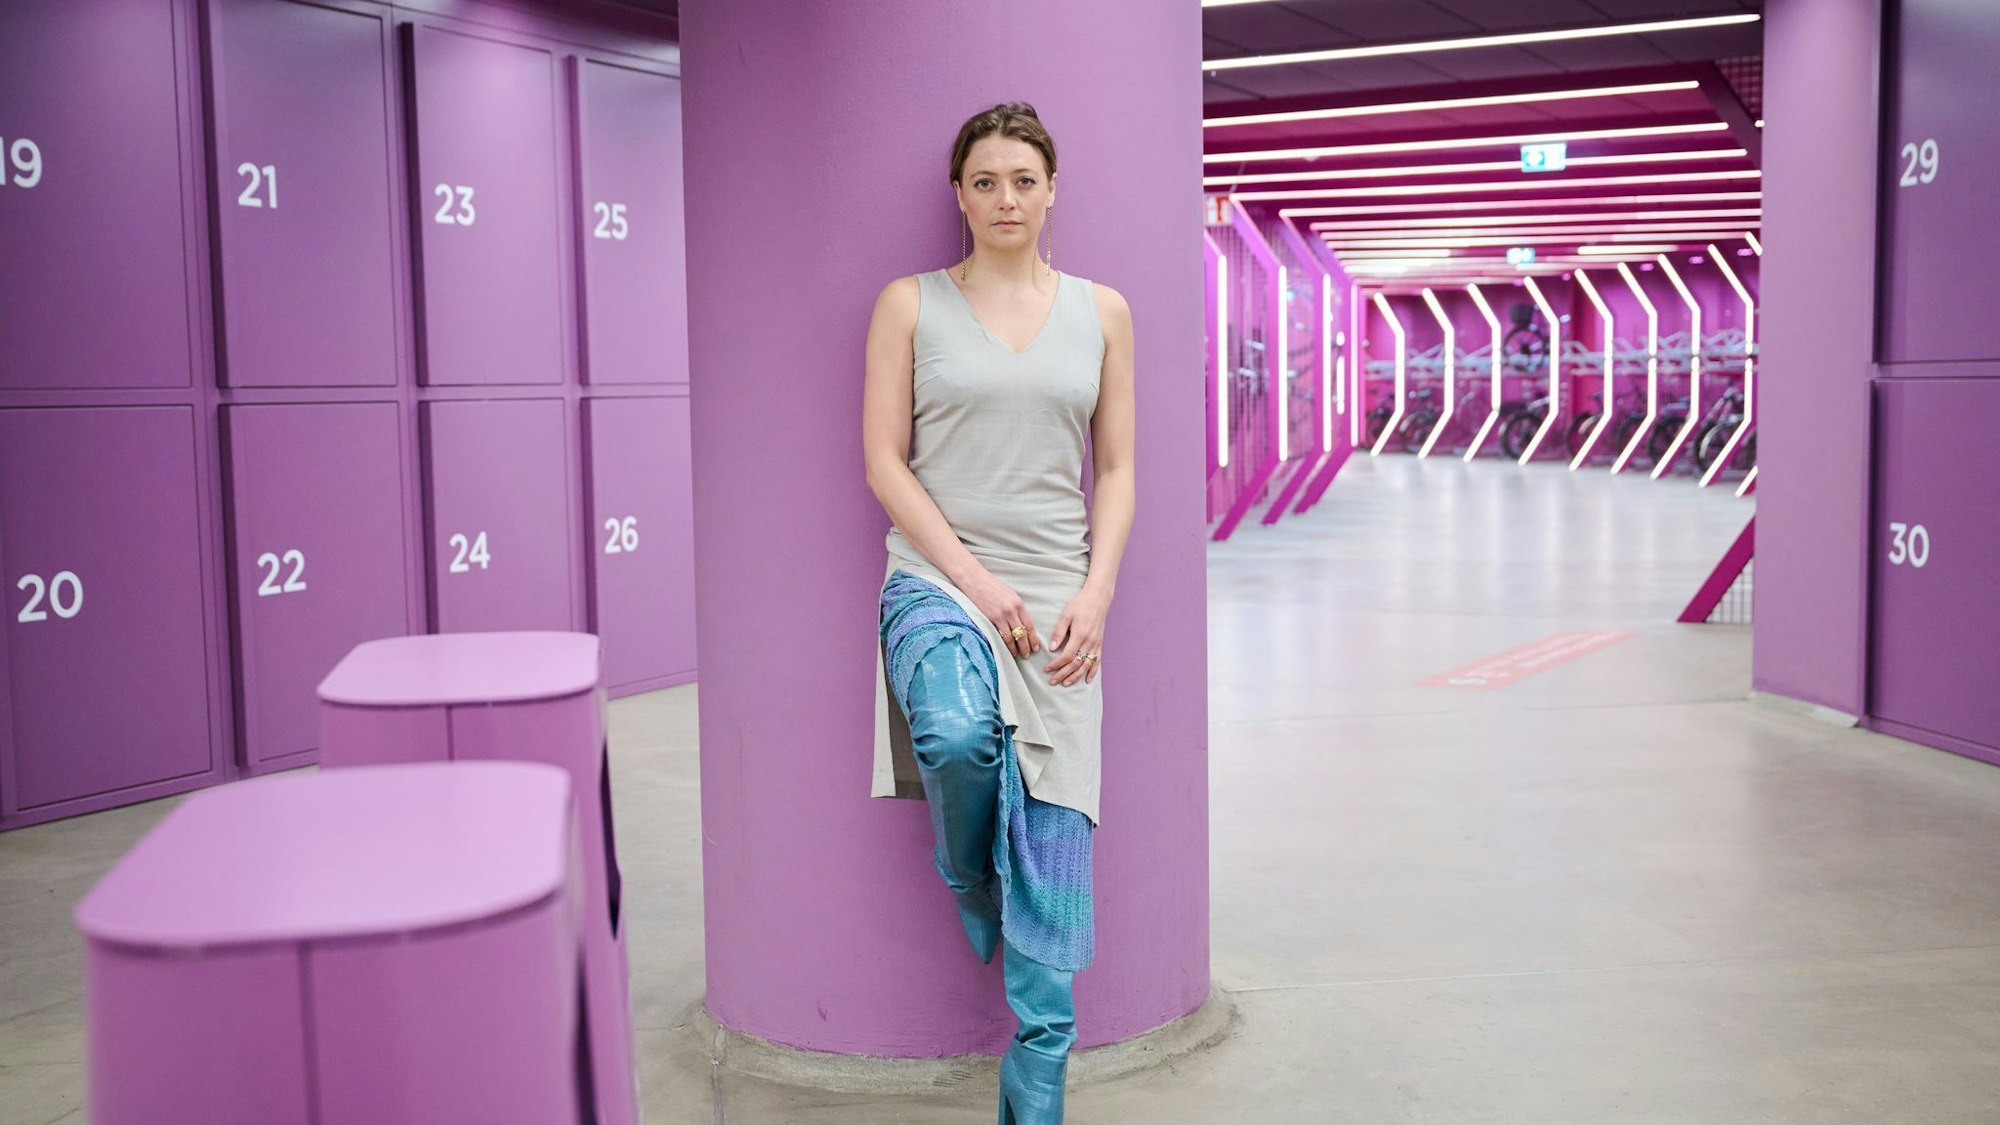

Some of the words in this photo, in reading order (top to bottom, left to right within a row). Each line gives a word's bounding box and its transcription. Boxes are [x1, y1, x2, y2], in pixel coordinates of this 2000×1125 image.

[237, 162, 278, 209] 21
[1899, 138, 1939, 187] 29
[434, 183, 476, 226] 23
[593, 201, 629, 241] 25
[449, 531, 491, 573] 24
[604, 515, 639, 554] 26
[1888, 522, 1930, 568] 30
[257, 549, 307, 596] 22
[17, 570, 84, 623] 20
